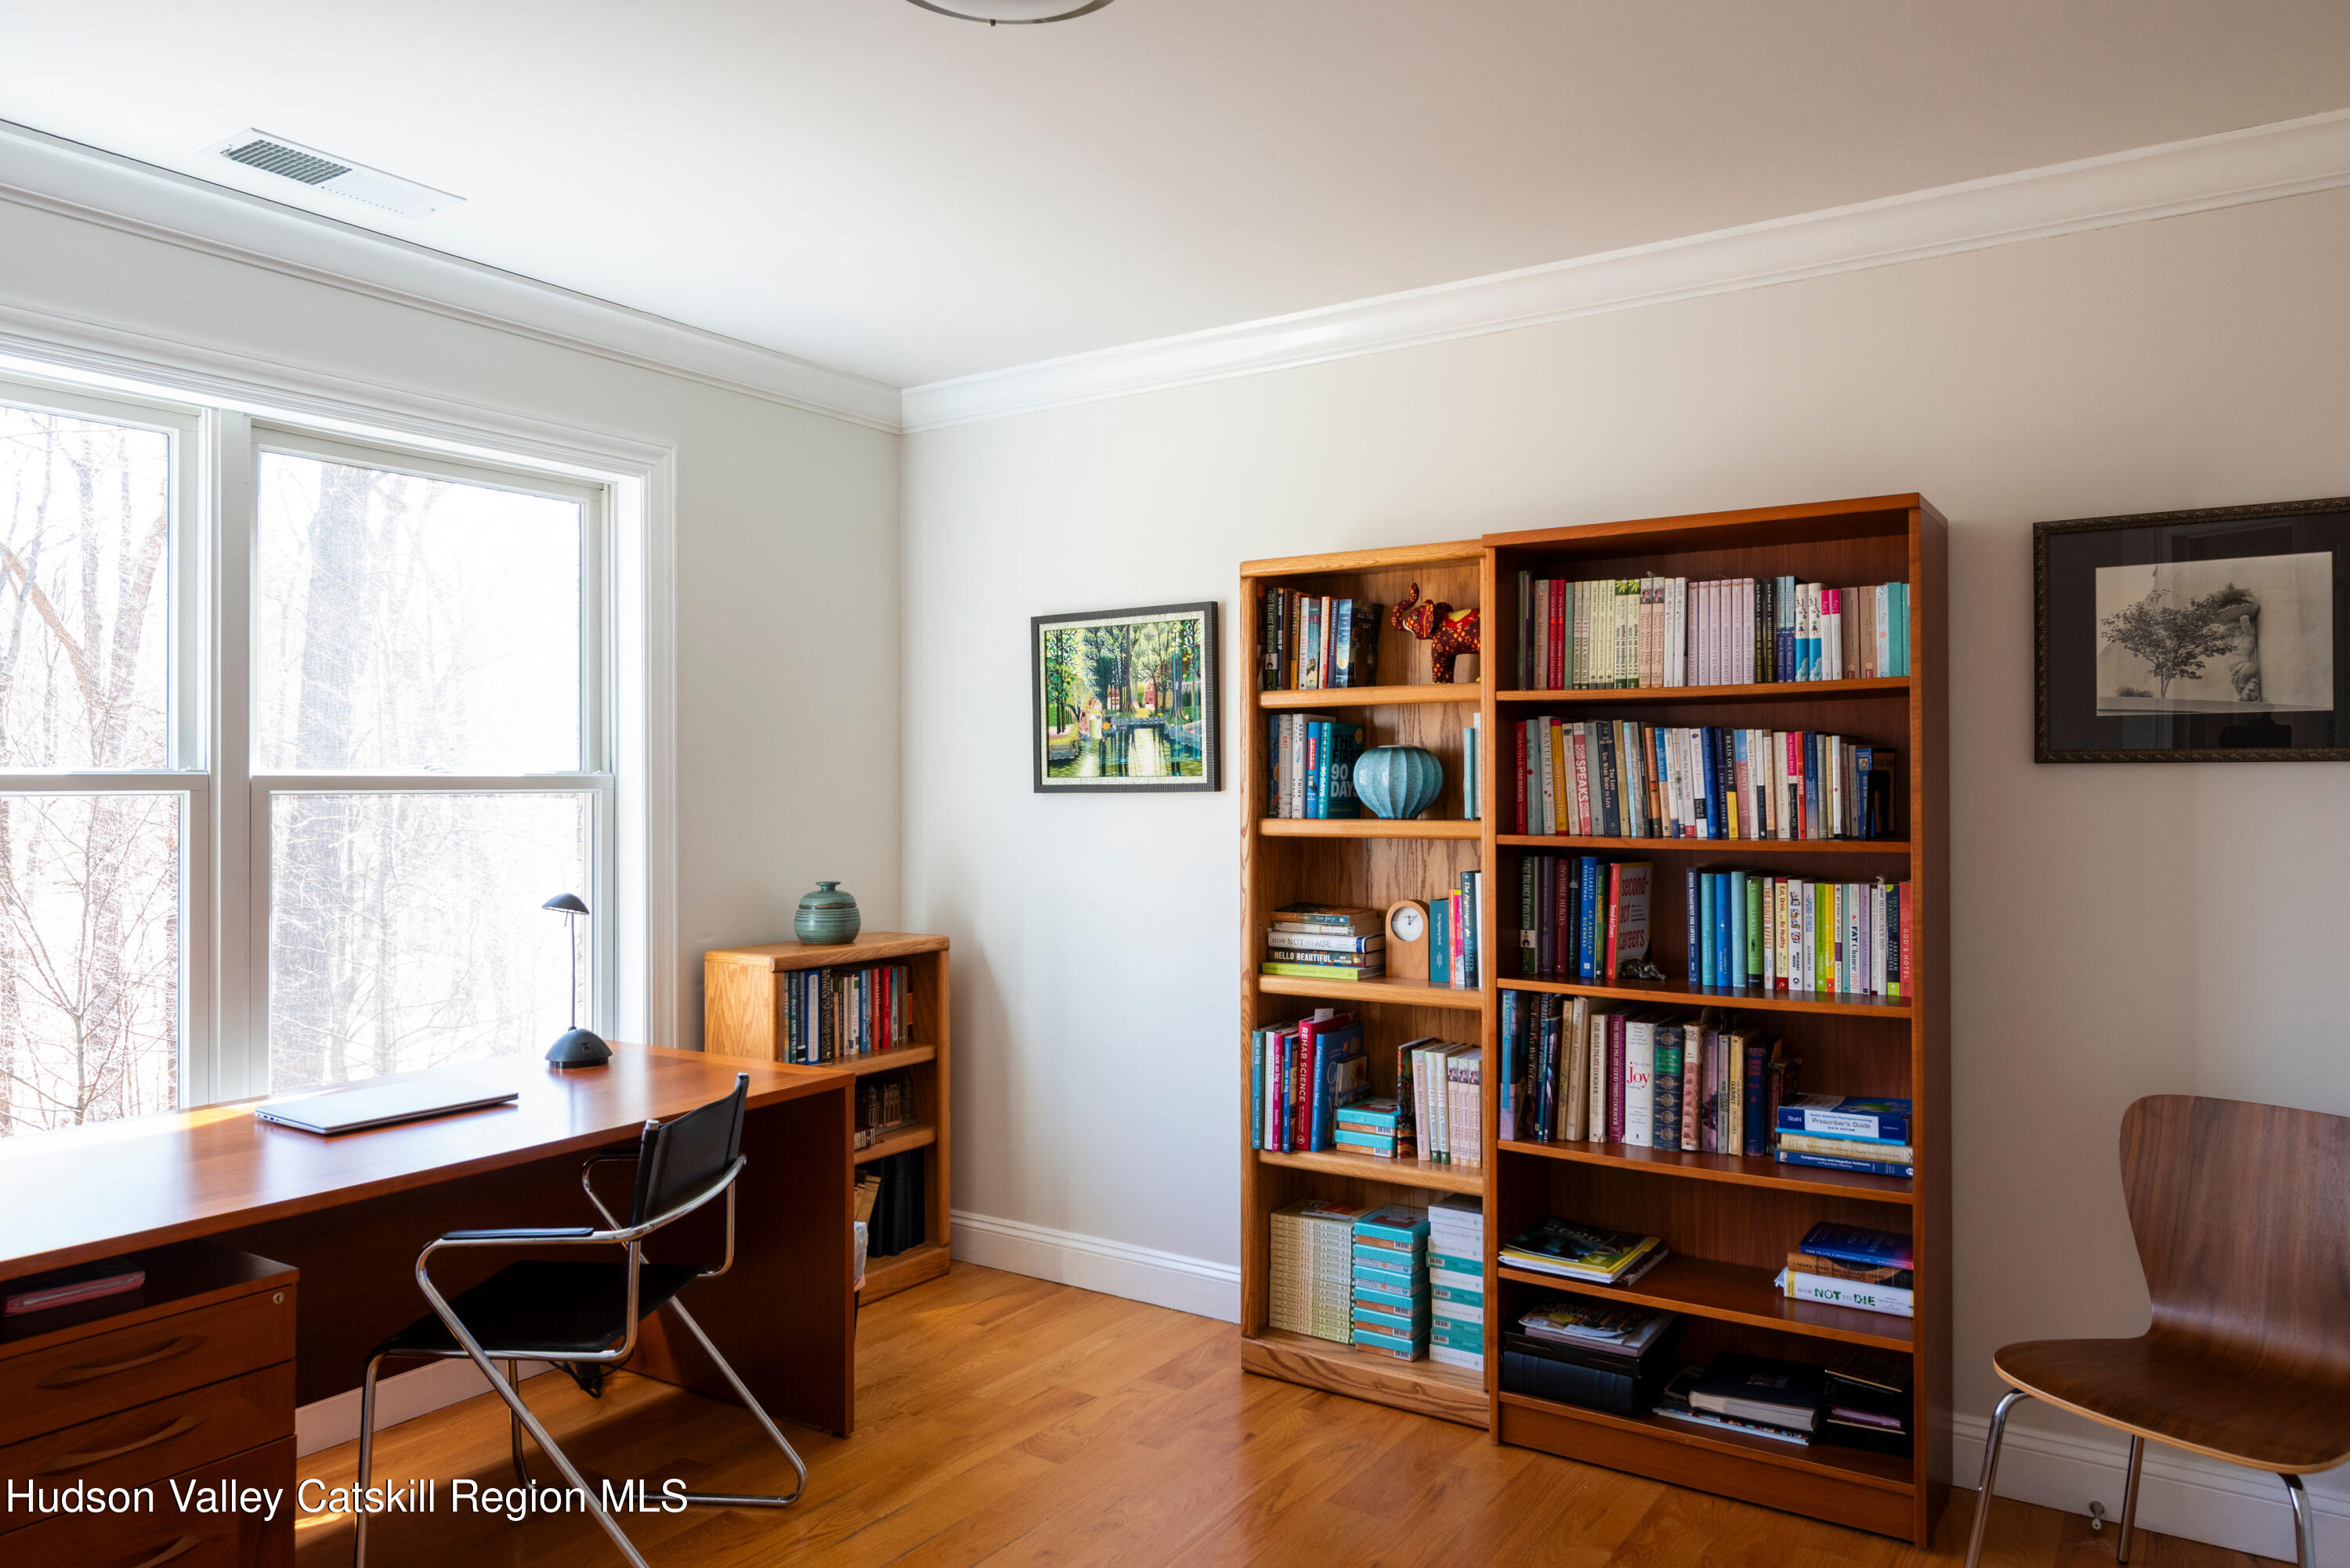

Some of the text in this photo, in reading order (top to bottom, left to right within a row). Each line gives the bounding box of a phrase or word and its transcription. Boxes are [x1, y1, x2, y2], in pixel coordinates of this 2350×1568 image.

[1727, 758, 1733, 767] ON
[1332, 764, 1348, 780] 90
[1576, 760, 1588, 801] SPEAKS
[1621, 869, 1649, 897] second-
[1588, 909, 1593, 919] AN
[1620, 901, 1630, 923] act
[1618, 929, 1644, 951] careers
[1274, 951, 1332, 963] HELLO BEAUTIFUL
[1626, 1061, 1651, 1088] Joy
[1812, 1118, 1851, 1127] Prescriber's
[1814, 1288, 1842, 1300] NOT
[1854, 1294, 1875, 1306] DIE
